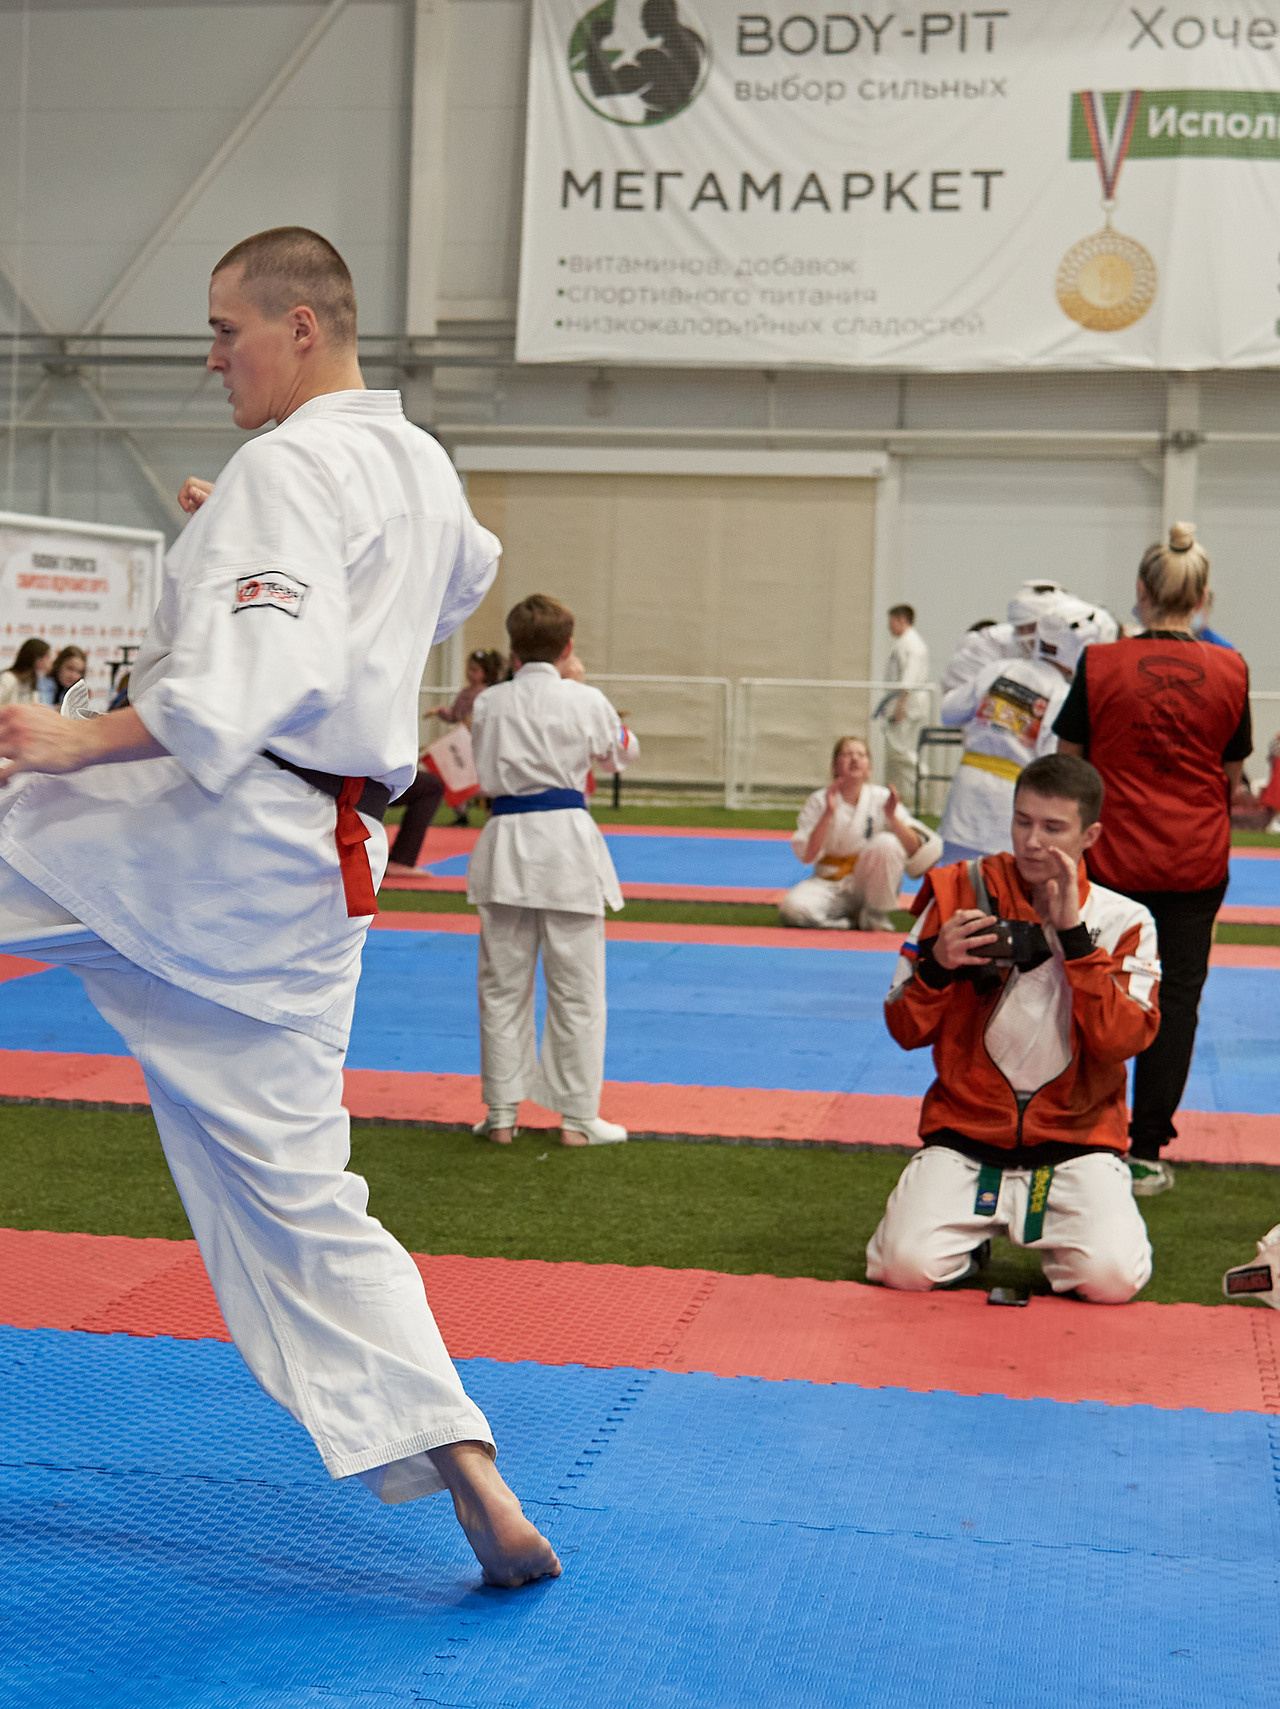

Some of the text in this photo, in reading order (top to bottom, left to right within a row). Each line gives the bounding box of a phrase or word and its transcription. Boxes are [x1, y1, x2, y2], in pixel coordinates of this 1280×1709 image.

[736, 11, 1010, 57] BODY-PIT
[734, 73, 1009, 105] выбор сильных
[1147, 105, 1280, 140] Испол
[562, 170, 1005, 213] МЕГАМАРКЕТ
[732, 254, 857, 277] добавок
[567, 285, 878, 307] спортивного питания
